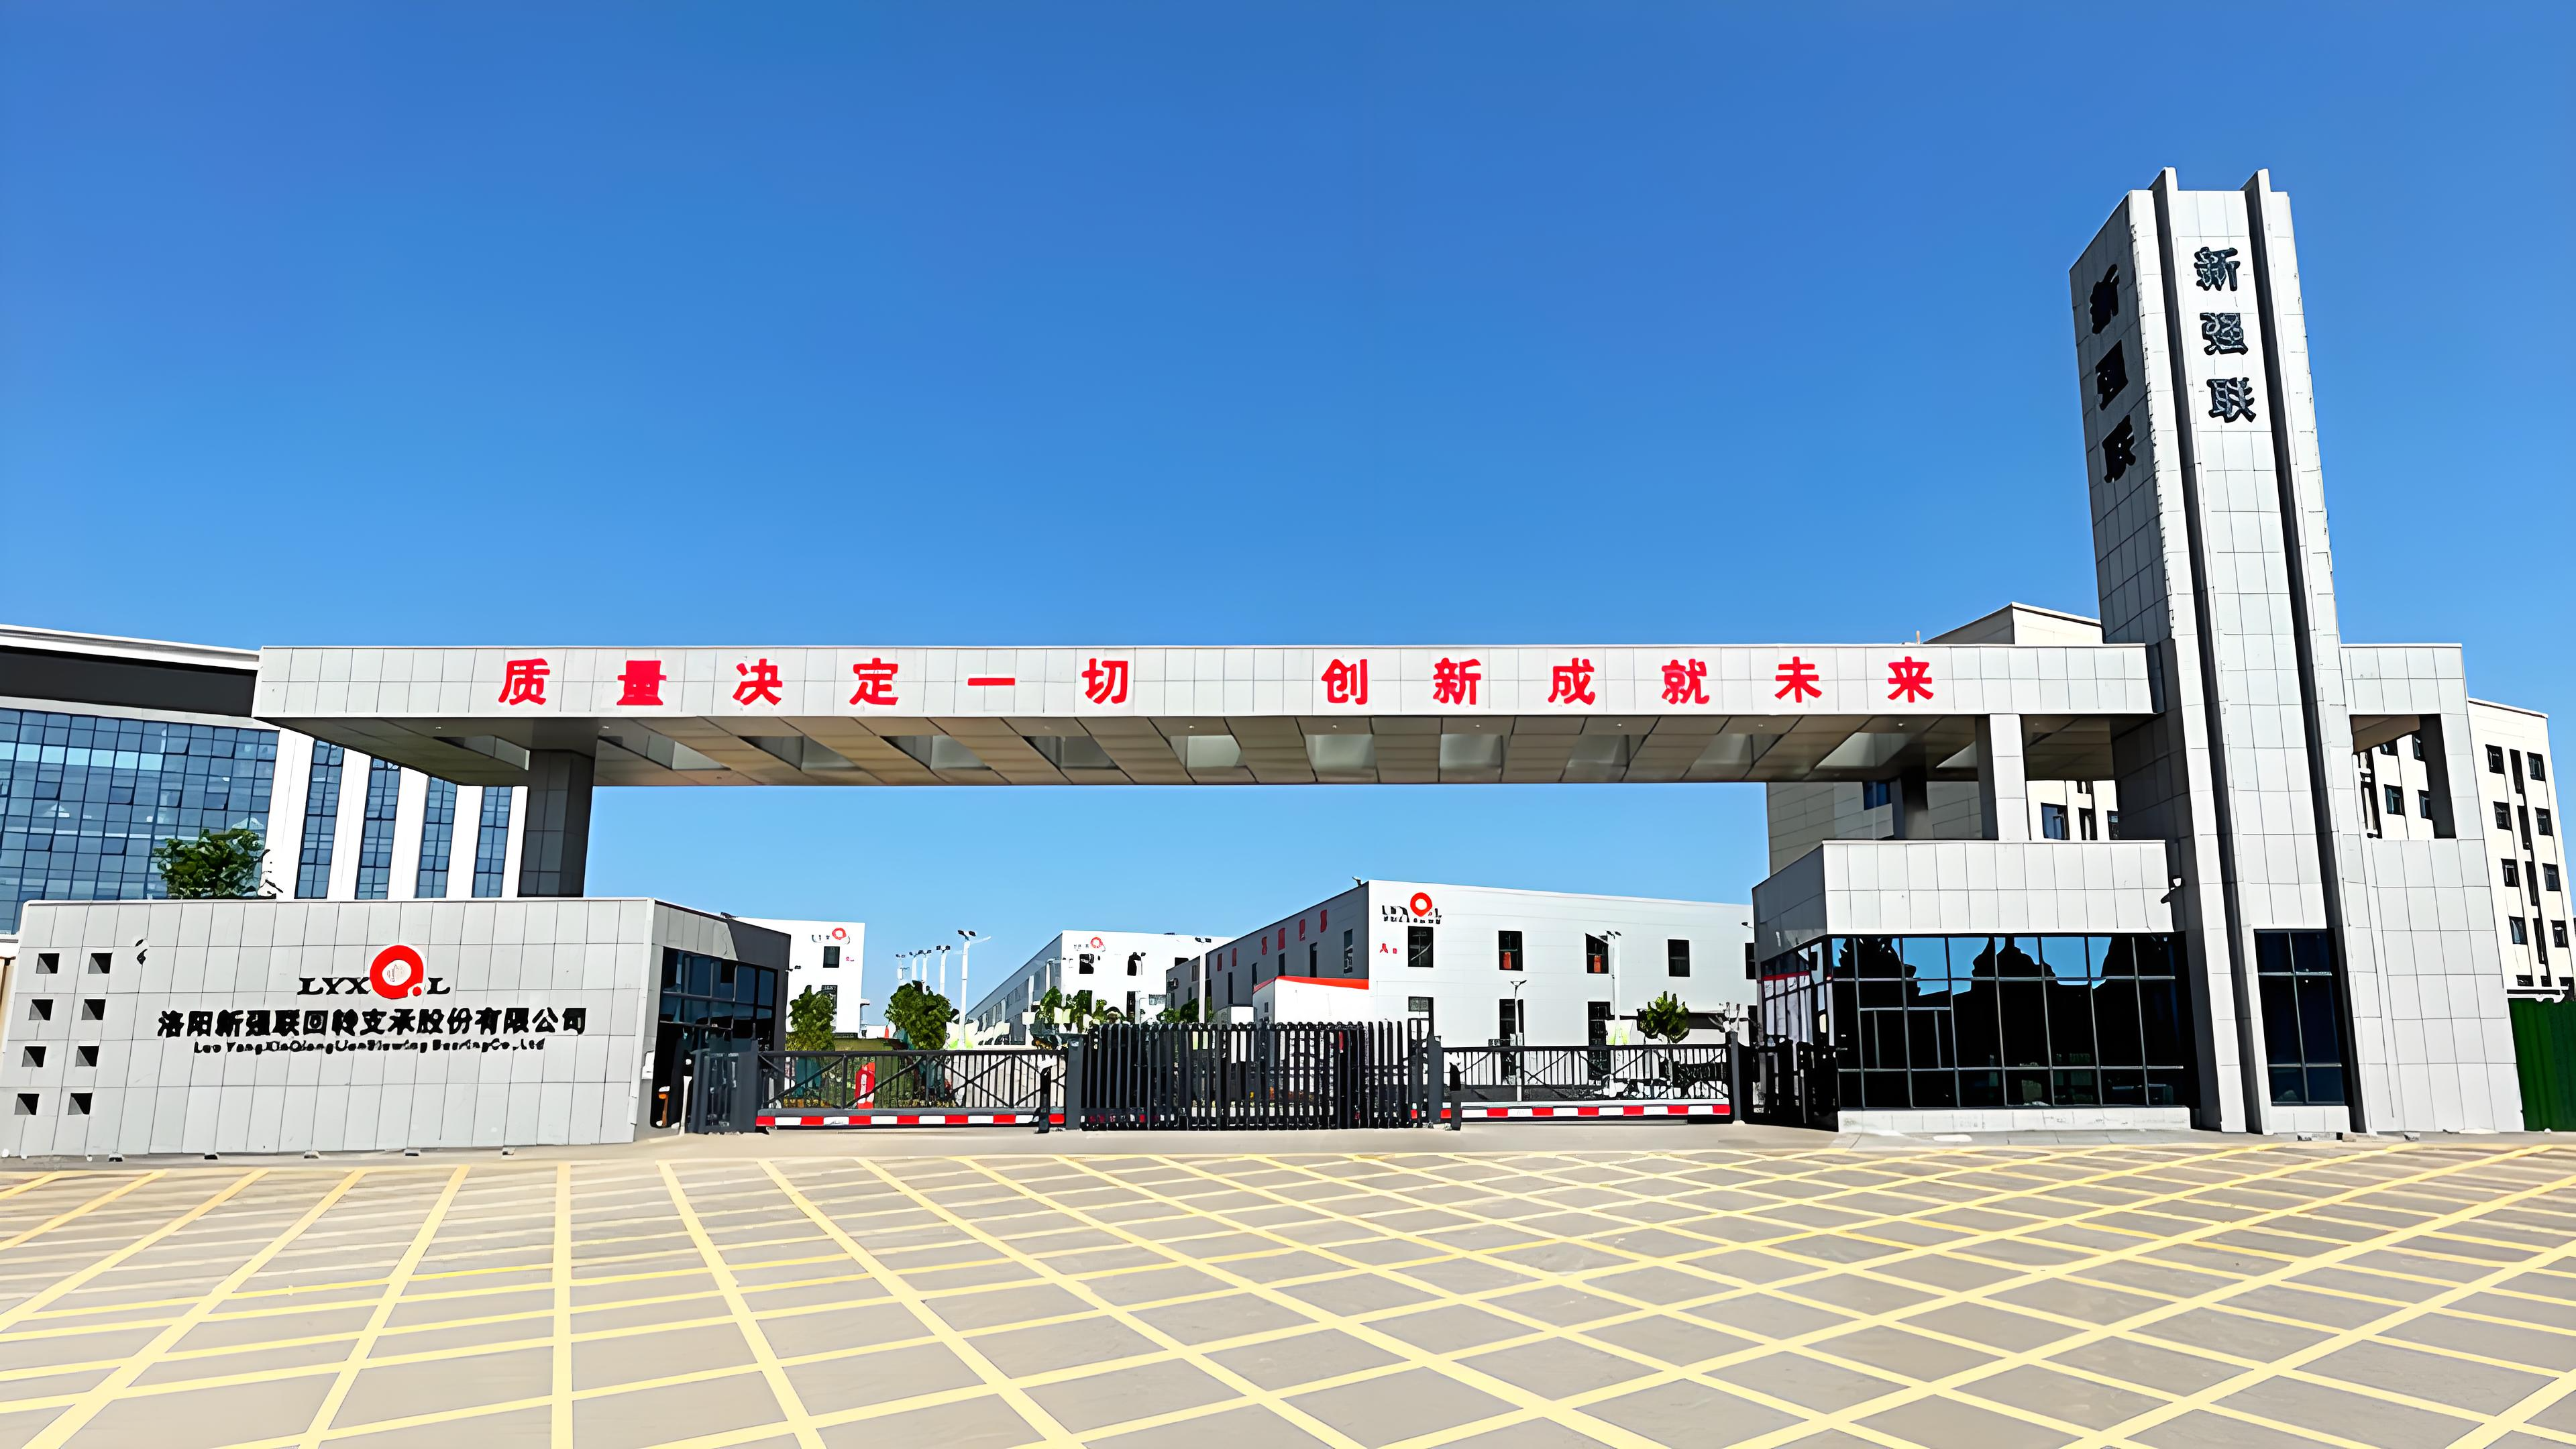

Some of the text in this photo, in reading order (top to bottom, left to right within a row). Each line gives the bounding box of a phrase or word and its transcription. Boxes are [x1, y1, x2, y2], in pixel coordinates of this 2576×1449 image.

[2194, 246, 2256, 423] 新强联
[498, 656, 1934, 706] 质量决定一切 创新成就未来
[158, 1007, 586, 1038] 洛阳新强联回转支承股份有限公司
